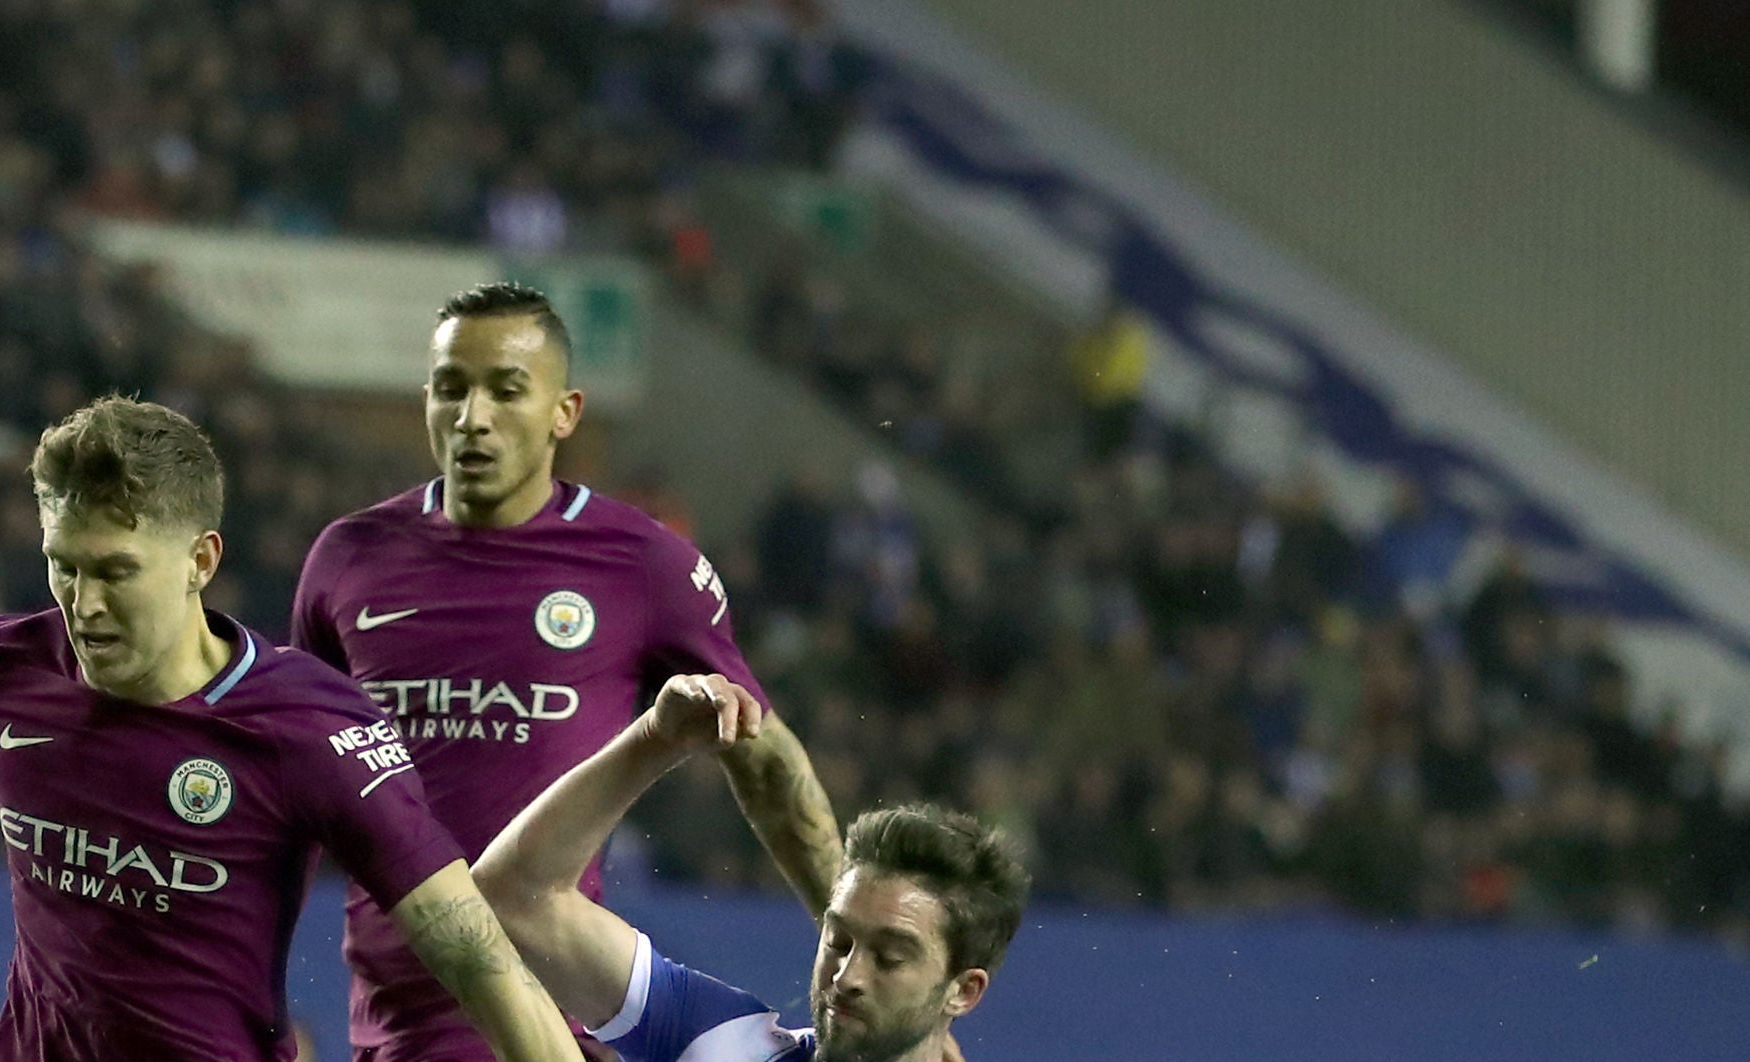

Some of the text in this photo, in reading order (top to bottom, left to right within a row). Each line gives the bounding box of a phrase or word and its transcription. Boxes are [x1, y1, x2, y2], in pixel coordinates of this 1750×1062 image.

[361, 678, 579, 720] ETIHAD
[176, 760, 229, 790] MANCHESTER
[356, 742, 412, 772] TIRE
[184, 811, 205, 823] CITY
[0, 806, 229, 893] ETIHAD
[31, 861, 171, 914] AIRWAYS
